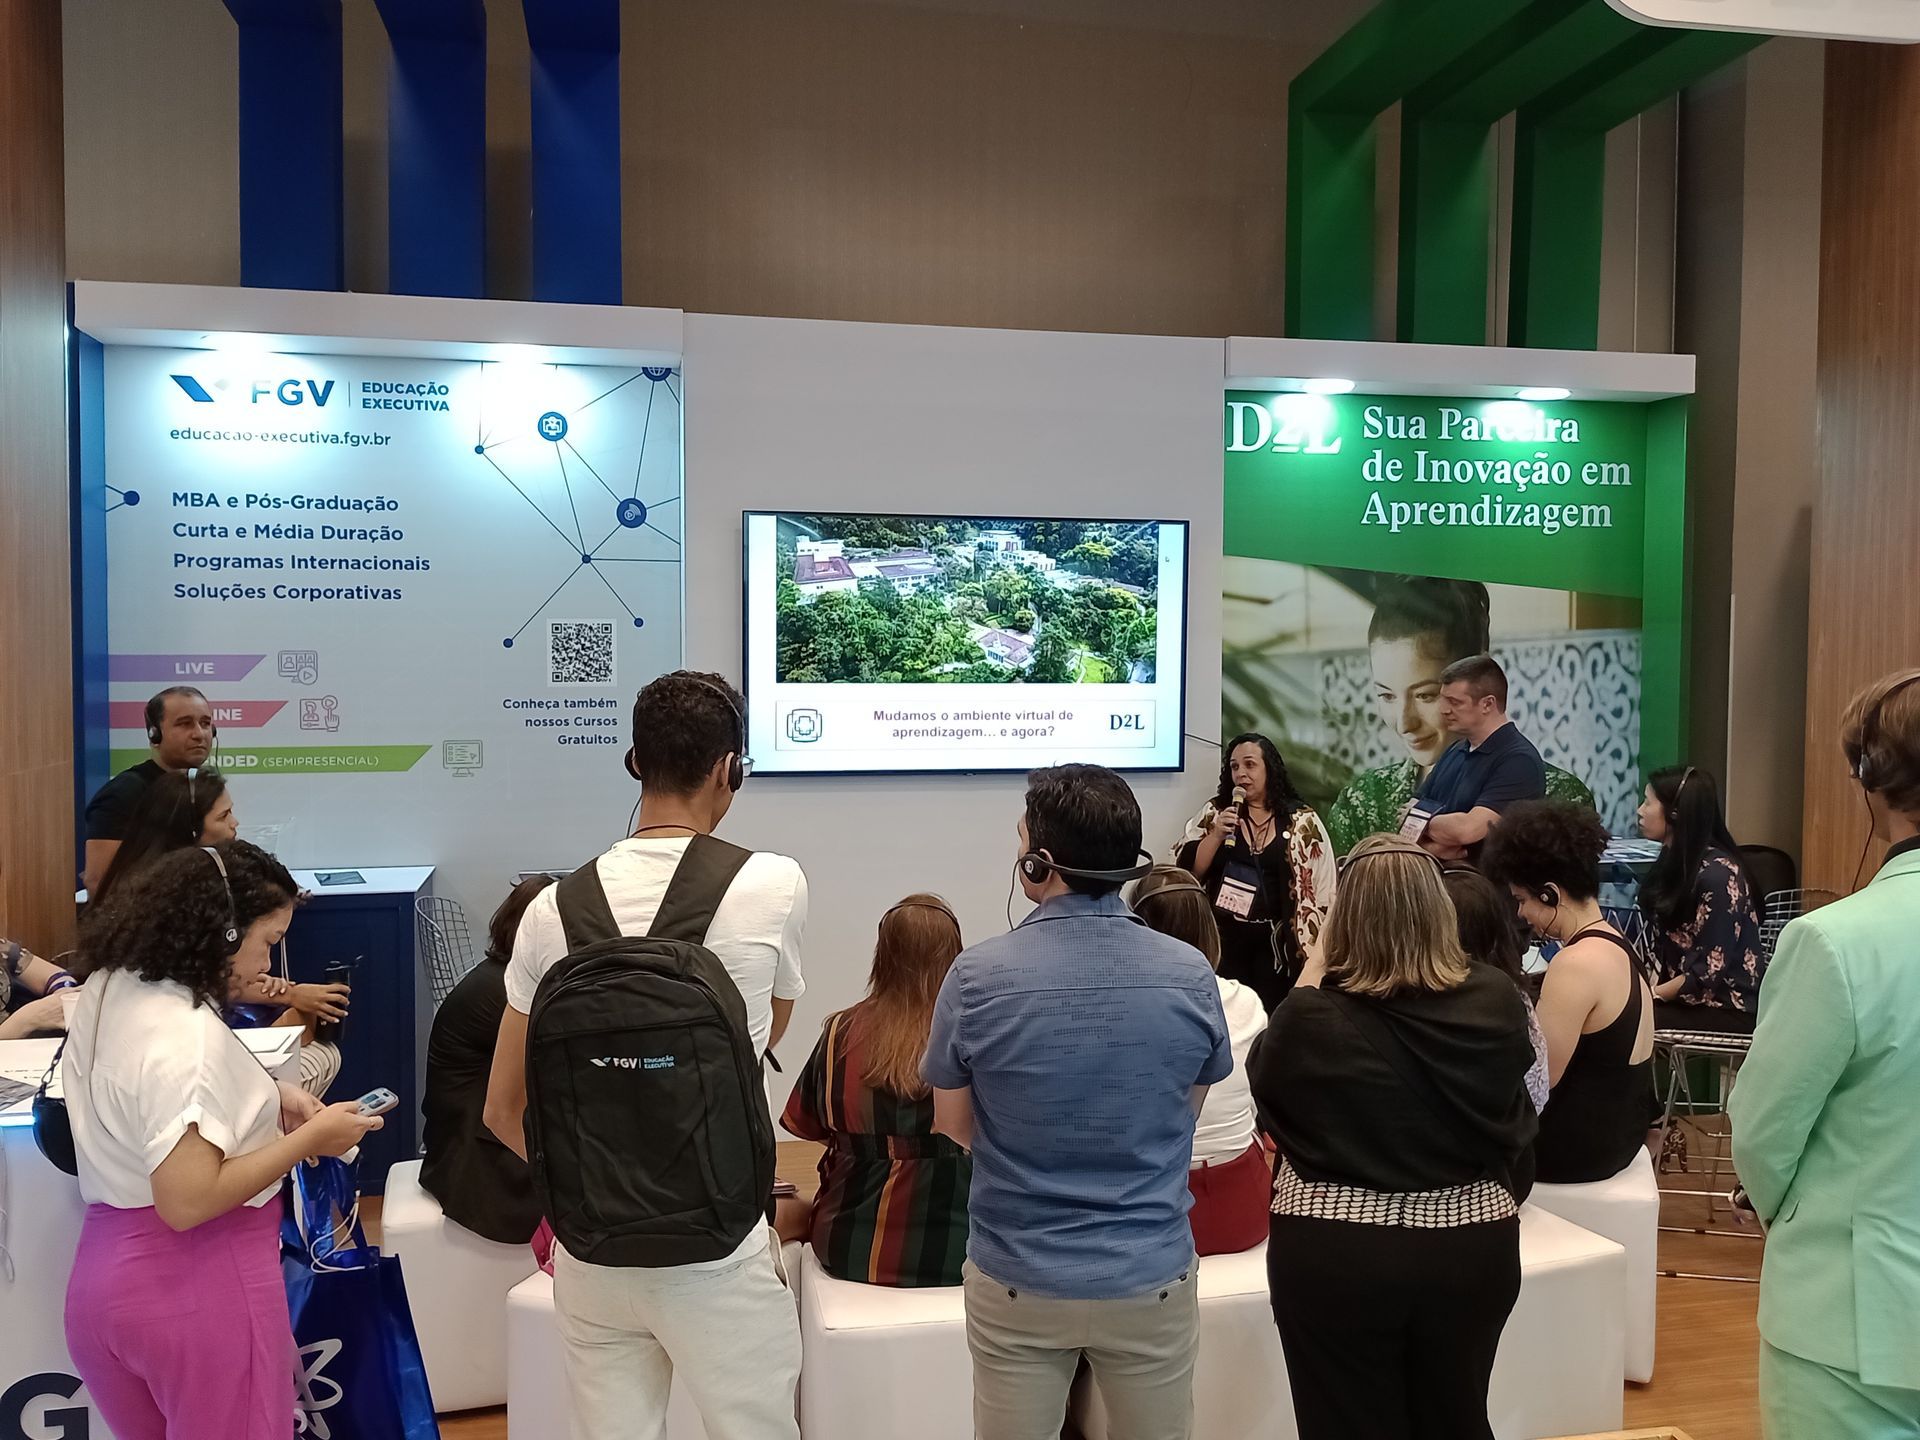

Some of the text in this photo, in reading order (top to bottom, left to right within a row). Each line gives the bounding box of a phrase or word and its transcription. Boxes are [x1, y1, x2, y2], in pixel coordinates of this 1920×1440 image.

[251, 379, 335, 407] FGV
[361, 380, 450, 397] EDUCAÇÃO
[361, 397, 450, 412] EXECUTIVA
[1362, 405, 1427, 440] Sua
[170, 427, 392, 447] educacao-executiva.fgv.br
[1361, 449, 1632, 492] de Inovação em
[172, 492, 399, 513] MBA e Pós-Graduação
[1360, 490, 1613, 535] Aprendizagem
[172, 522, 404, 543] Curta e Média Duração
[173, 553, 431, 571] Programas Internacionais
[173, 582, 402, 601] Soluções Corporativas
[175, 662, 215, 675] LIVE
[502, 697, 617, 710] Conheça também
[212, 708, 243, 721] INE
[525, 716, 618, 727] nossos Cursos
[873, 710, 1074, 721] Mudamos o ambiente virtual de
[1109, 714, 1145, 730] D2L
[557, 734, 618, 745] Gratuitos
[892, 725, 1055, 738] aprendizagem... e agora?
[206, 755, 380, 768] NDED (SEMIPRESENCIAL)
[612, 1057, 638, 1069] FGV
